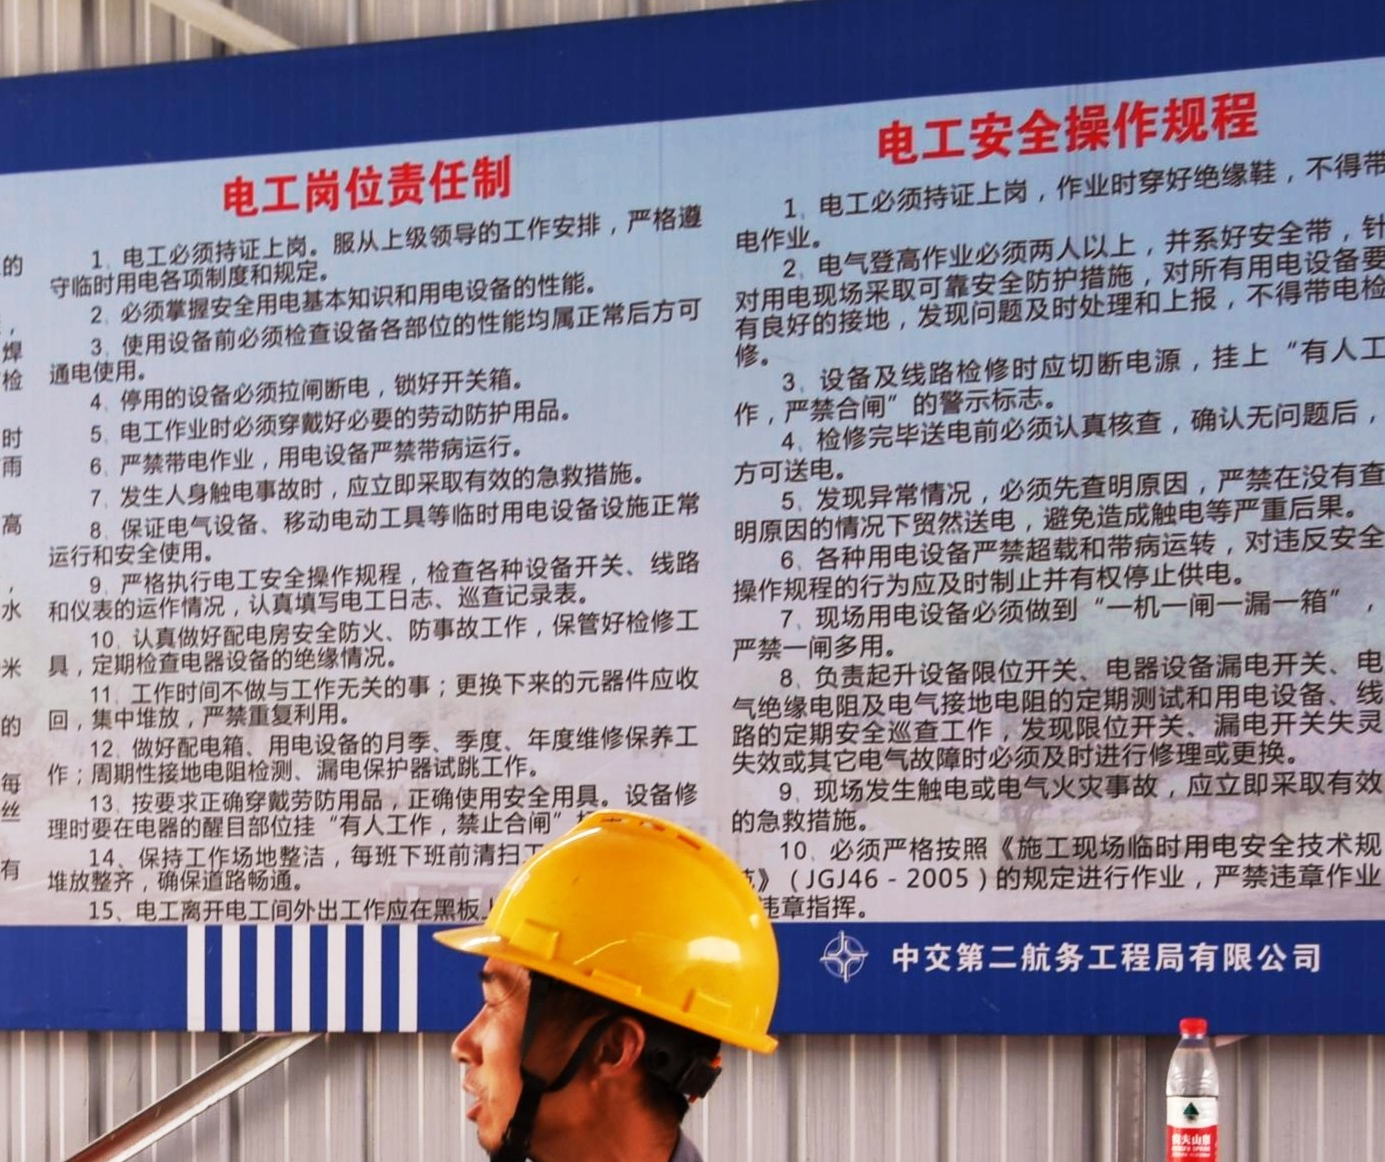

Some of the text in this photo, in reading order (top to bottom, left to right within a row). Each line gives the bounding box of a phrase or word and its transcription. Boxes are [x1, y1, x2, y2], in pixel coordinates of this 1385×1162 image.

[878, 90, 1258, 167] 电工安全操作规程
[224, 154, 510, 219] 电工岗位责任制
[892, 942, 1322, 974] 中交第二航务工程局有限公司
